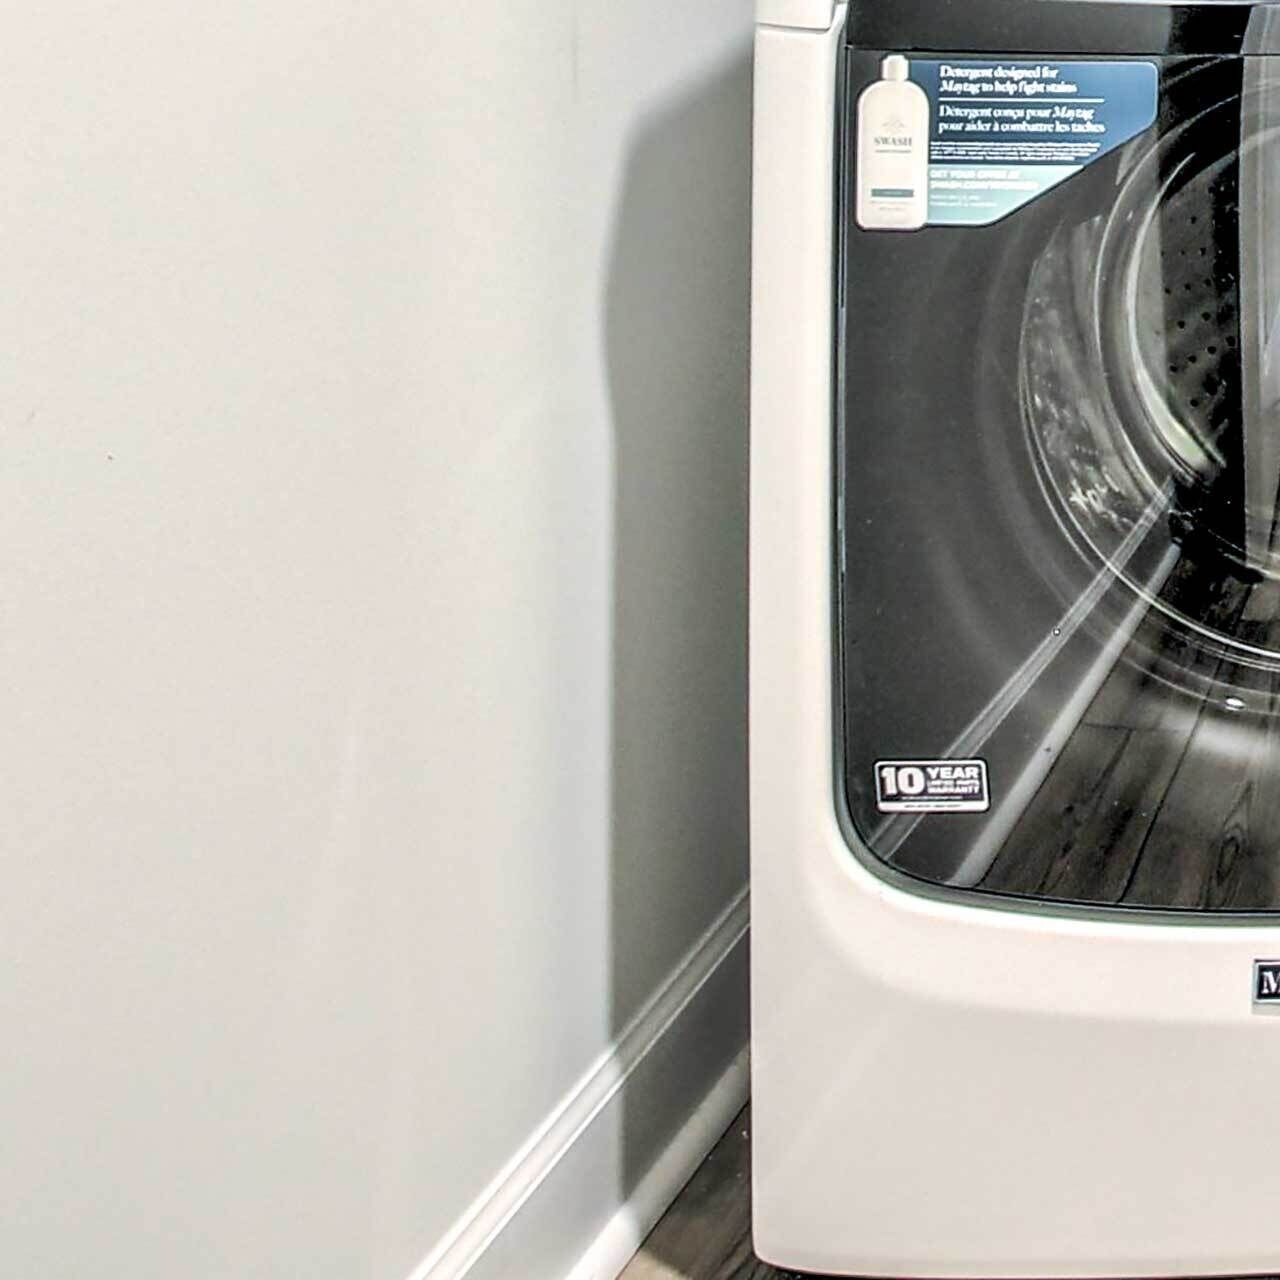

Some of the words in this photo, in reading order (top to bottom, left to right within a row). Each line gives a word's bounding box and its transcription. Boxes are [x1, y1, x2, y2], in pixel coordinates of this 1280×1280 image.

[939, 65, 993, 80] Detergent
[994, 65, 1041, 80] designed
[939, 80, 981, 95] Maytag
[994, 80, 1017, 95] help
[1052, 106, 1095, 120] Maytag
[874, 136, 912, 147] SWASH
[881, 766, 926, 795] 10
[925, 766, 980, 780] YEAR
